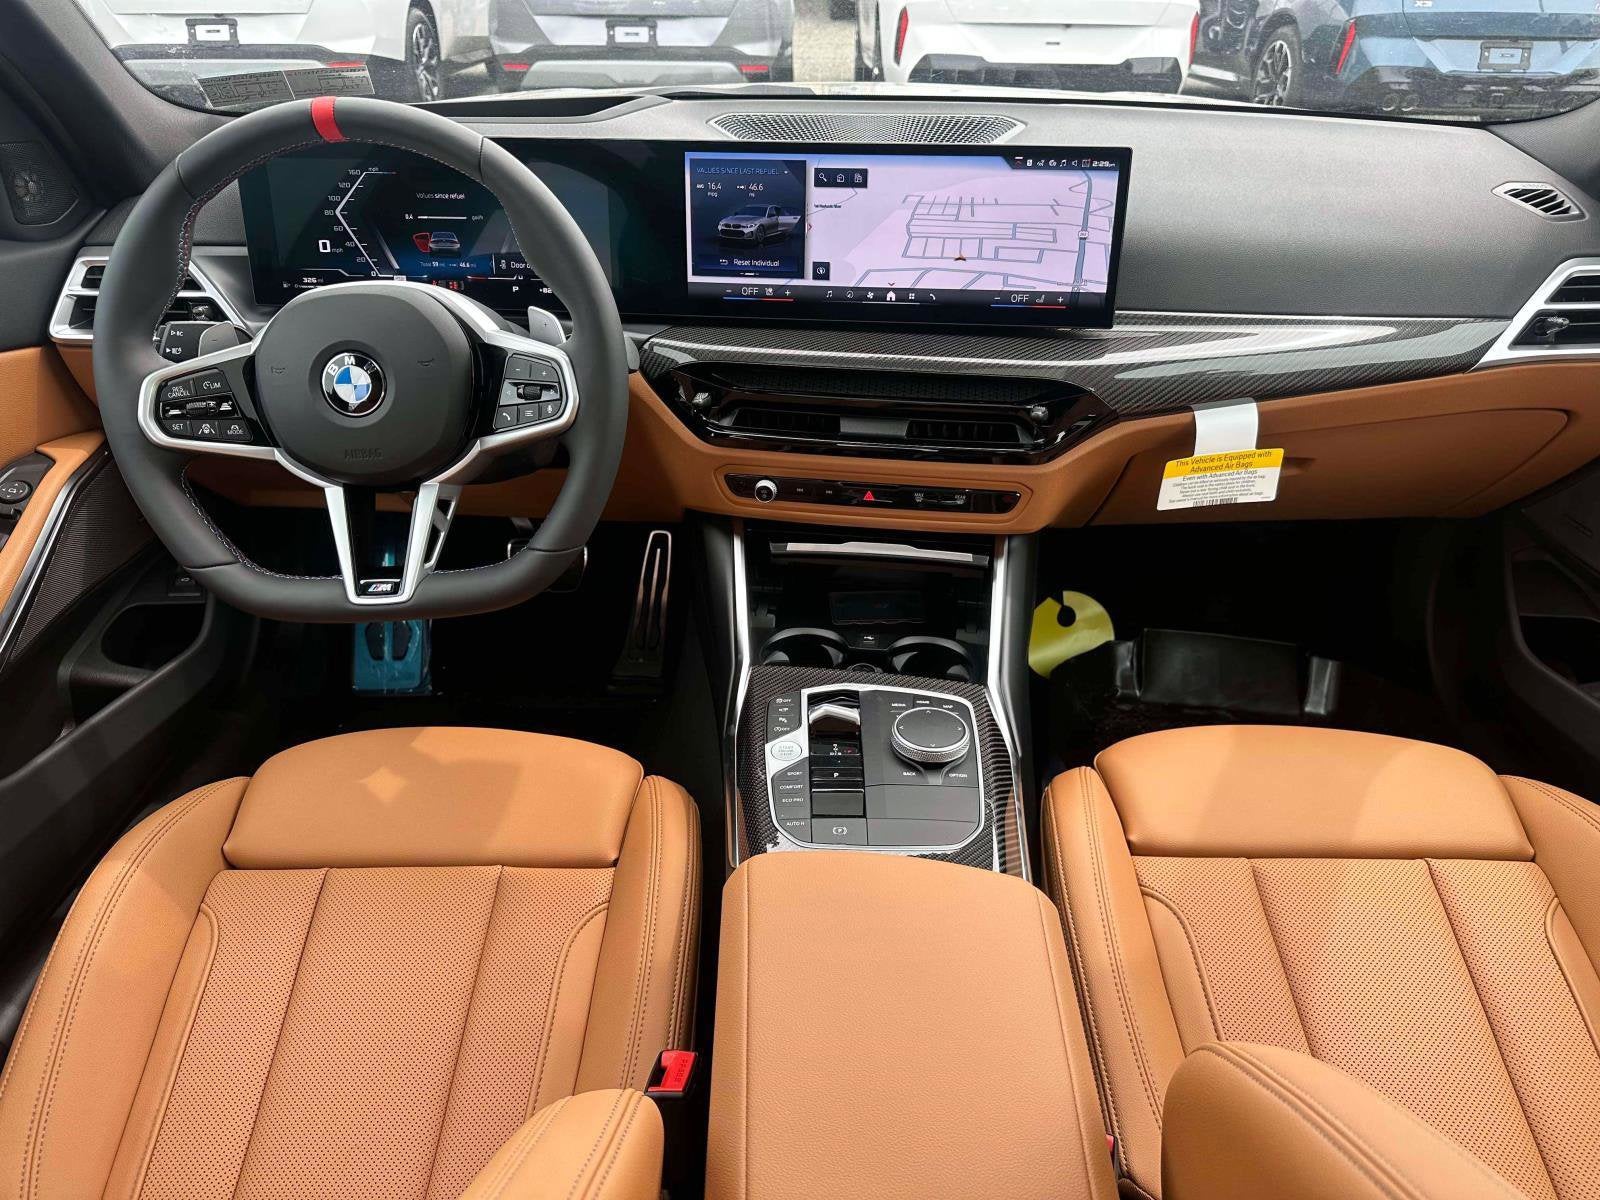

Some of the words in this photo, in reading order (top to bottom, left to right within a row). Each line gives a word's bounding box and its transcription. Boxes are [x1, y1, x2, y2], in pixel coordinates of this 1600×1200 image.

[707, 182, 722, 190] 16.4
[748, 183, 764, 191] 46.6
[318, 239, 331, 253] 0
[510, 261, 526, 269] Door
[733, 258, 751, 266] Reset
[751, 259, 780, 267] Individual
[741, 286, 759, 296] OFF
[1010, 293, 1029, 303] OFF
[327, 355, 377, 377] BMW
[168, 390, 191, 399] CANCEL
[172, 423, 184, 431] SET
[344, 447, 384, 459] AIRBAG
[1191, 456, 1215, 465] Vehicle
[1223, 452, 1256, 462] Equipped
[1257, 450, 1272, 458] with
[1190, 463, 1223, 473] Advanced
[1224, 462, 1234, 470] Air
[1235, 460, 1253, 469] Bags
